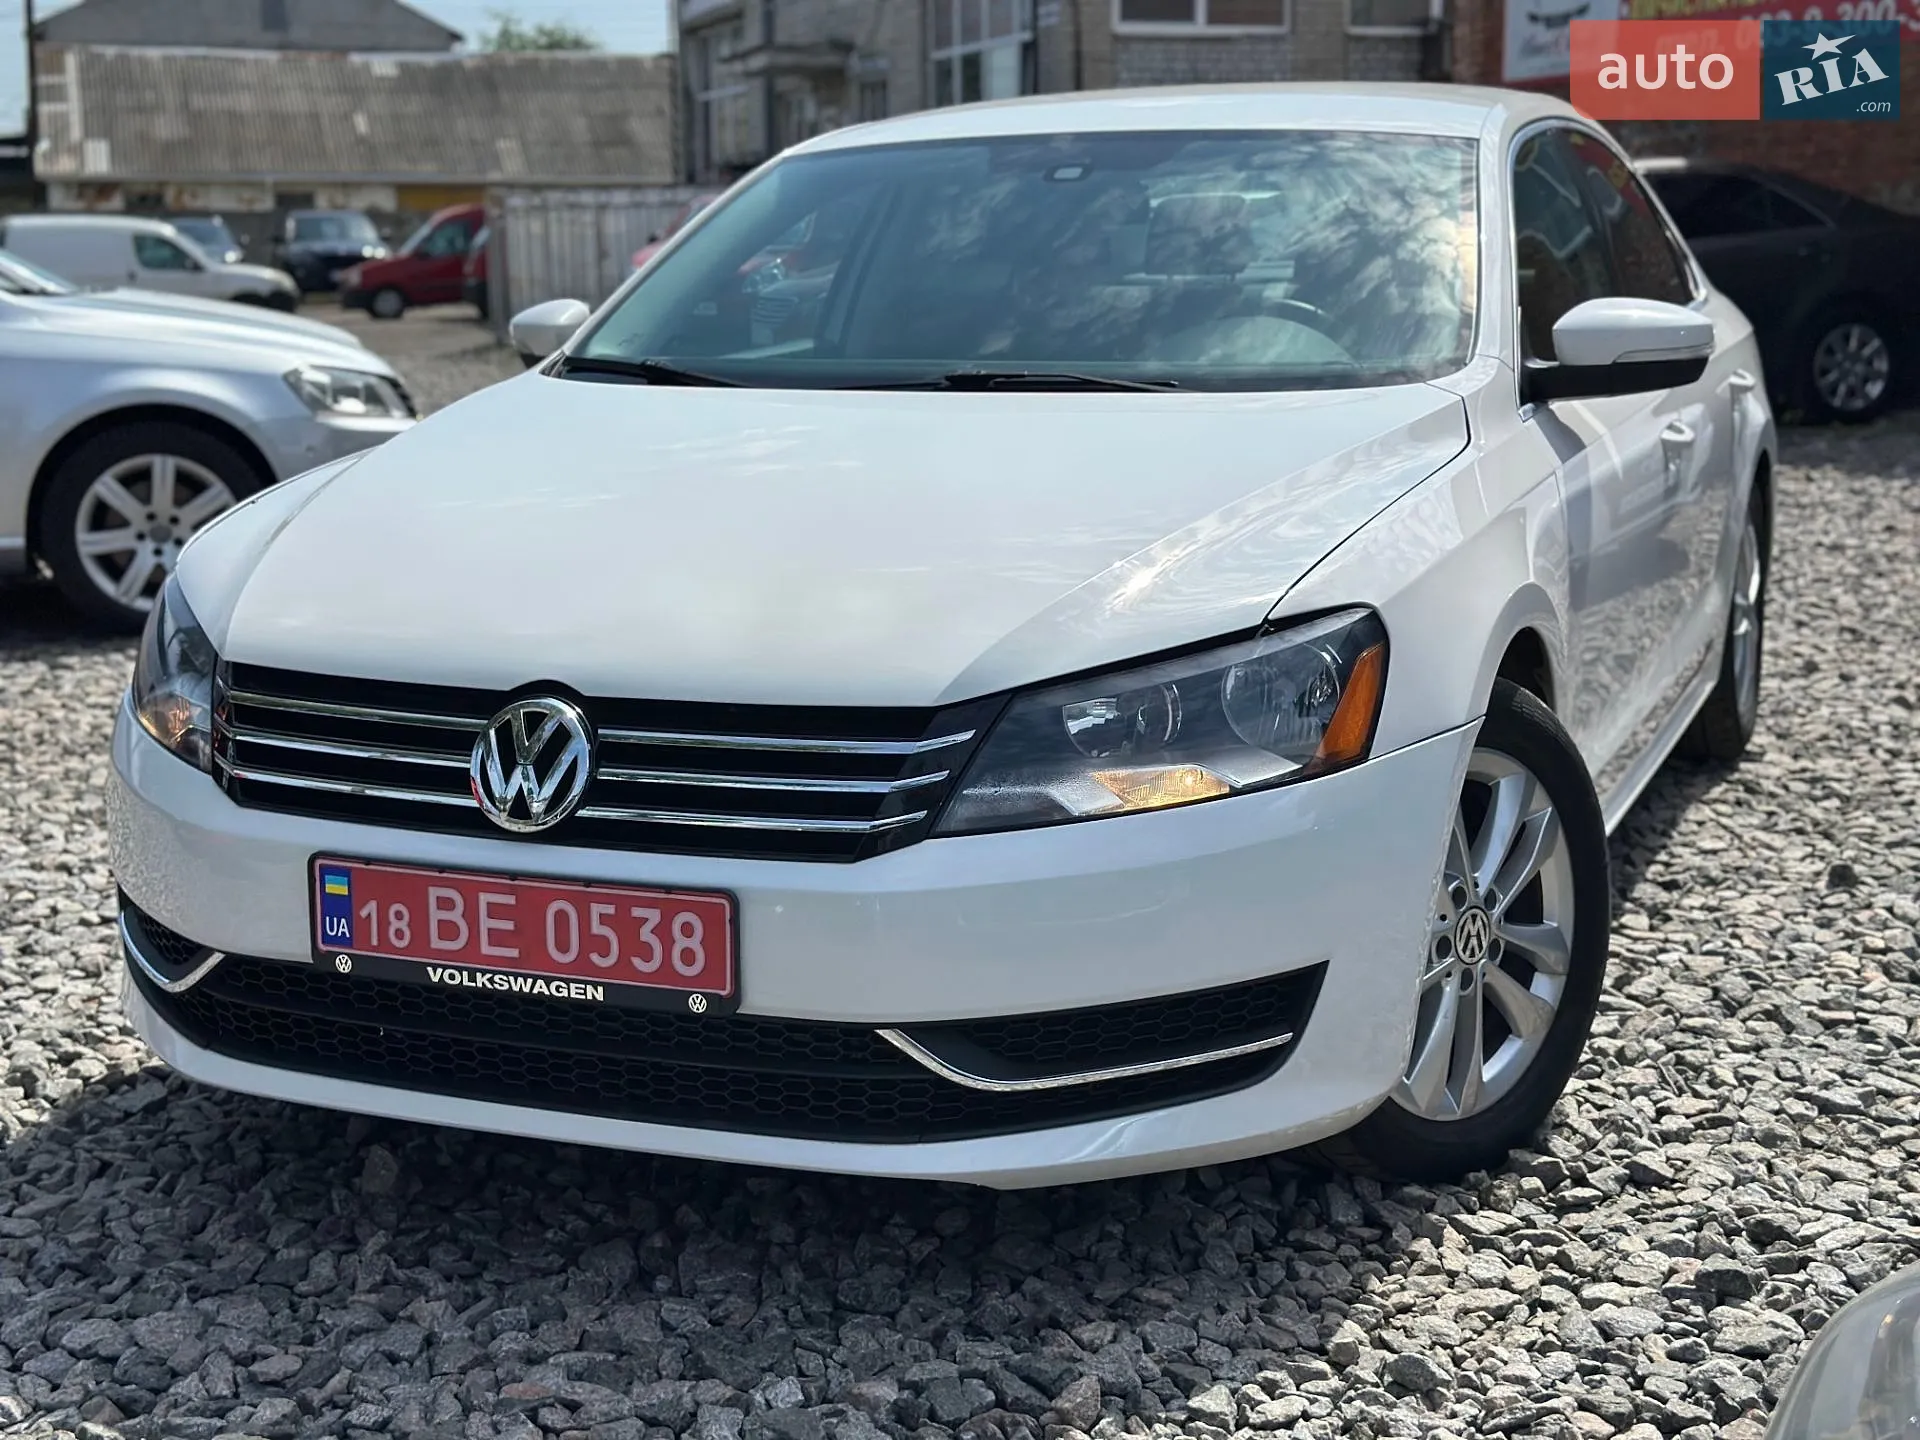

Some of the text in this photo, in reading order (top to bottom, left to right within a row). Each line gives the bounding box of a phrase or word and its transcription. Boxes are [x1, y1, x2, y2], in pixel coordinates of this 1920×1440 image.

[326, 916, 350, 938] UA
[359, 886, 706, 977] 18 BE 0538
[426, 967, 604, 1001] VOLKSWAGEN
